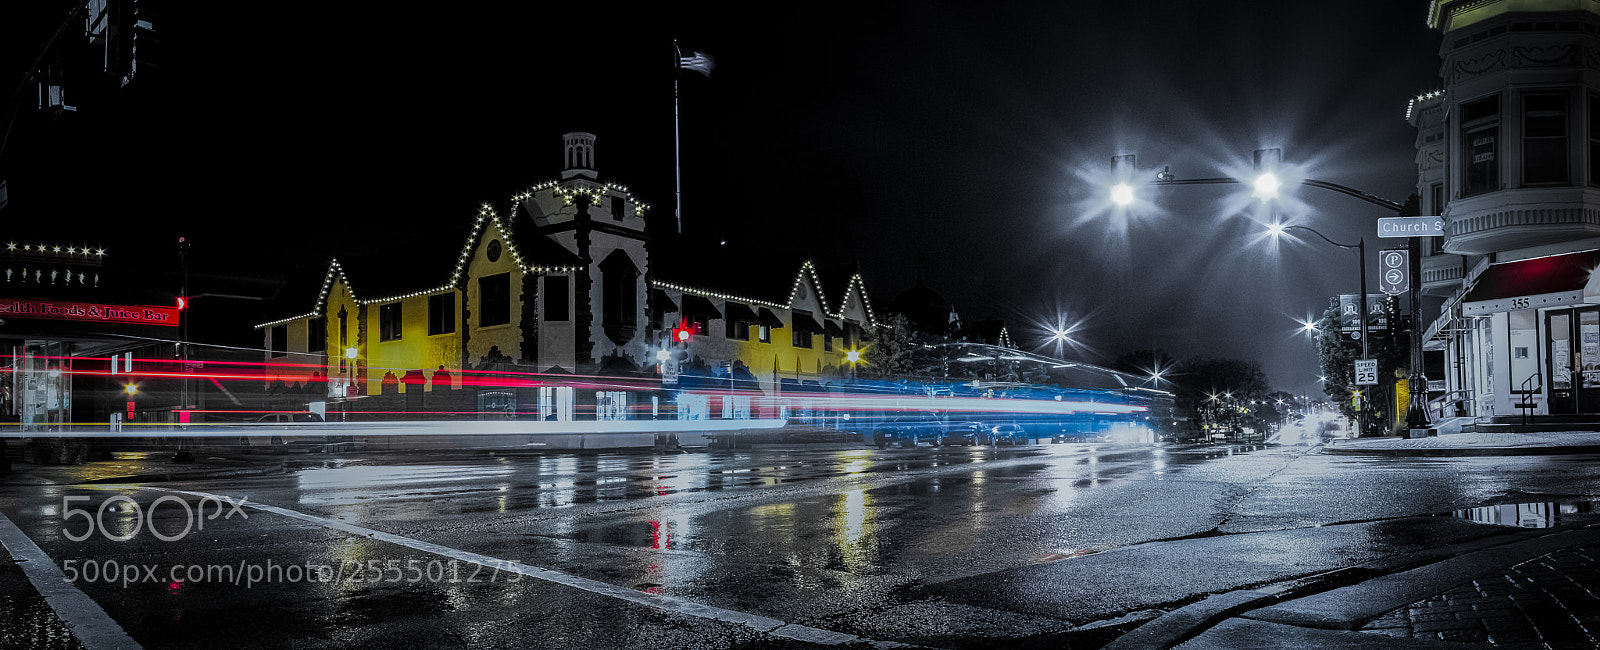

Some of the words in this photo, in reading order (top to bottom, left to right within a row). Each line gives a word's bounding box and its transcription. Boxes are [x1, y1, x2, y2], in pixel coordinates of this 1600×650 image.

[1383, 222, 1428, 232] Church
[1434, 221, 1445, 231] S
[1391, 256, 1399, 265] P
[1510, 298, 1530, 310] 355
[39, 303, 86, 316] Foods
[87, 306, 102, 317] &
[102, 307, 139, 319] Juice
[143, 309, 169, 321] Bar
[1358, 373, 1375, 382] 25
